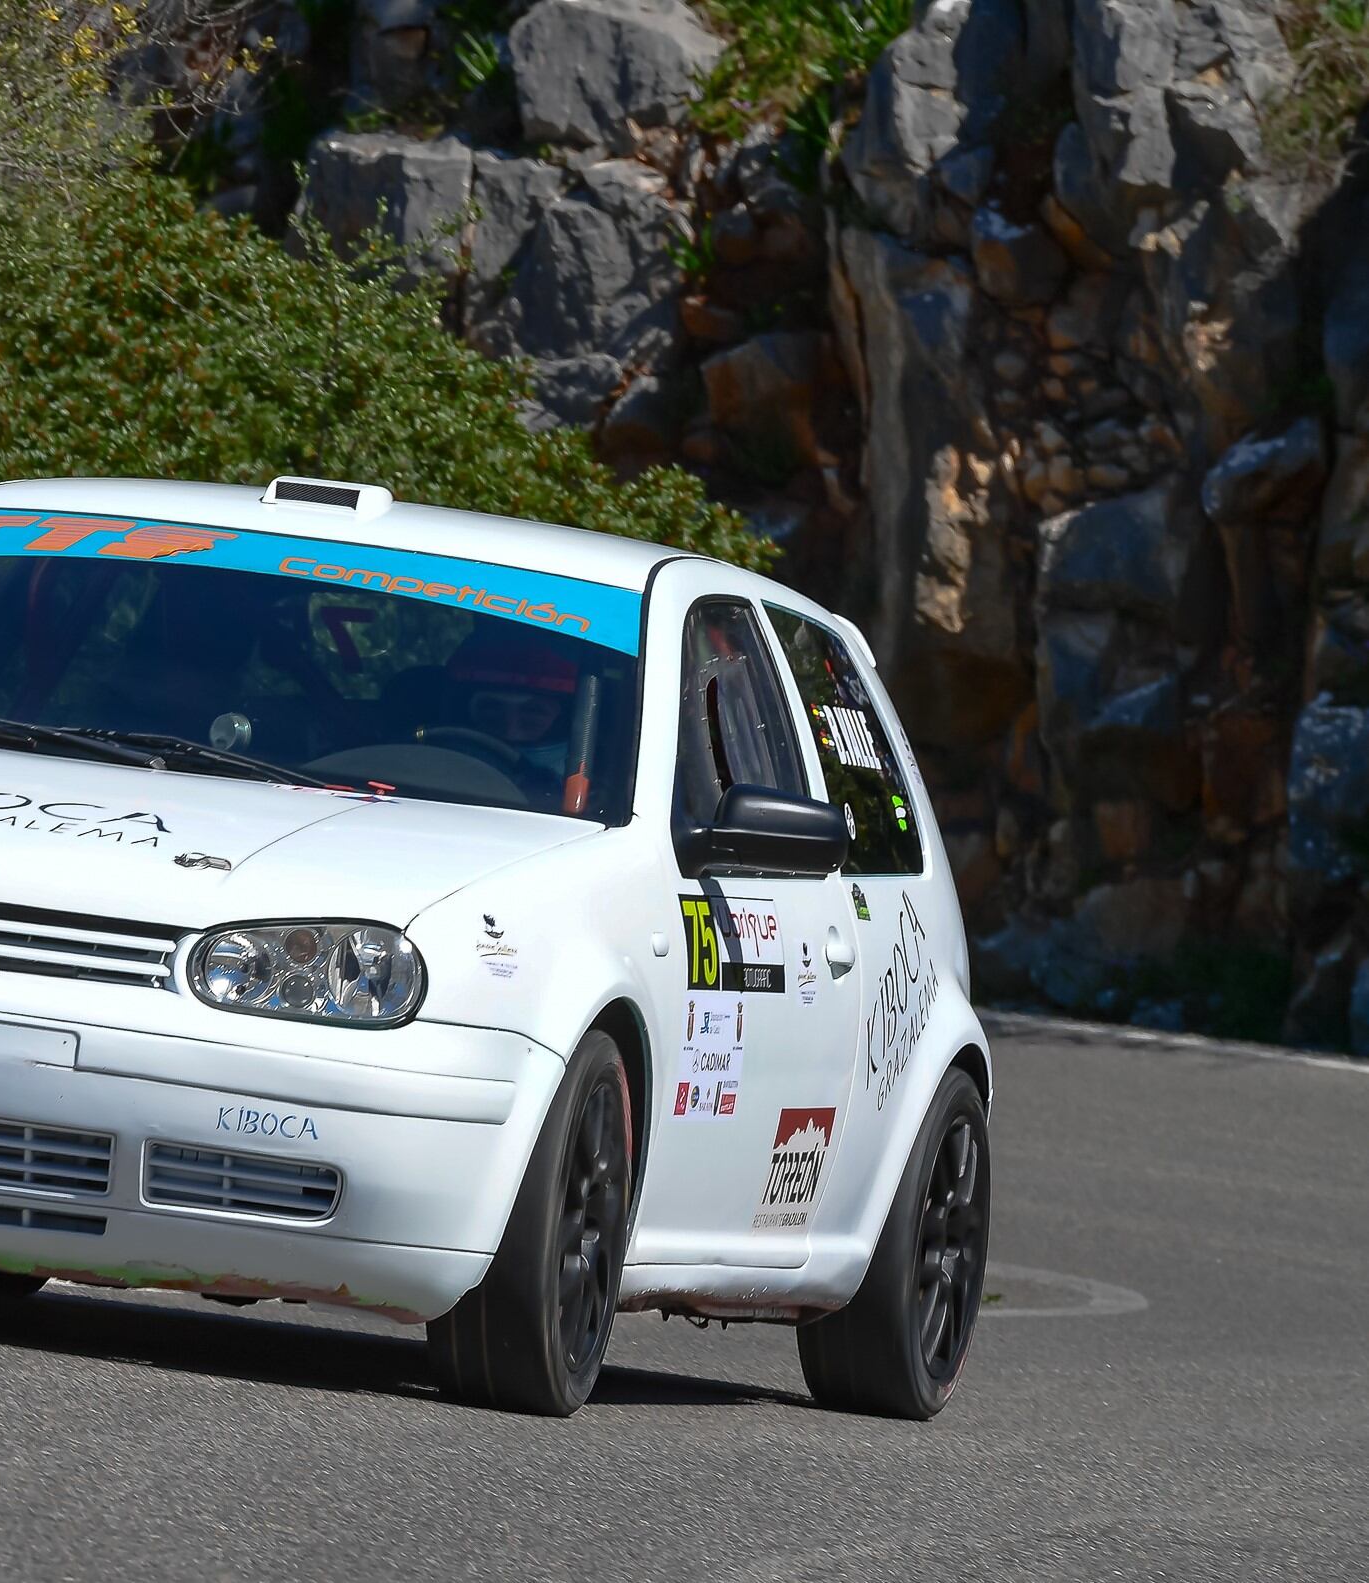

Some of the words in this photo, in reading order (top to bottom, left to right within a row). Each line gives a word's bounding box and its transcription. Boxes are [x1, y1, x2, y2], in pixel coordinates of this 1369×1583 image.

[278, 554, 591, 633] Competición
[681, 900, 719, 986] 75
[865, 889, 926, 1092] KIBOCA
[876, 958, 940, 1112] GRAZALEMA
[215, 1105, 319, 1141] KIBOCA
